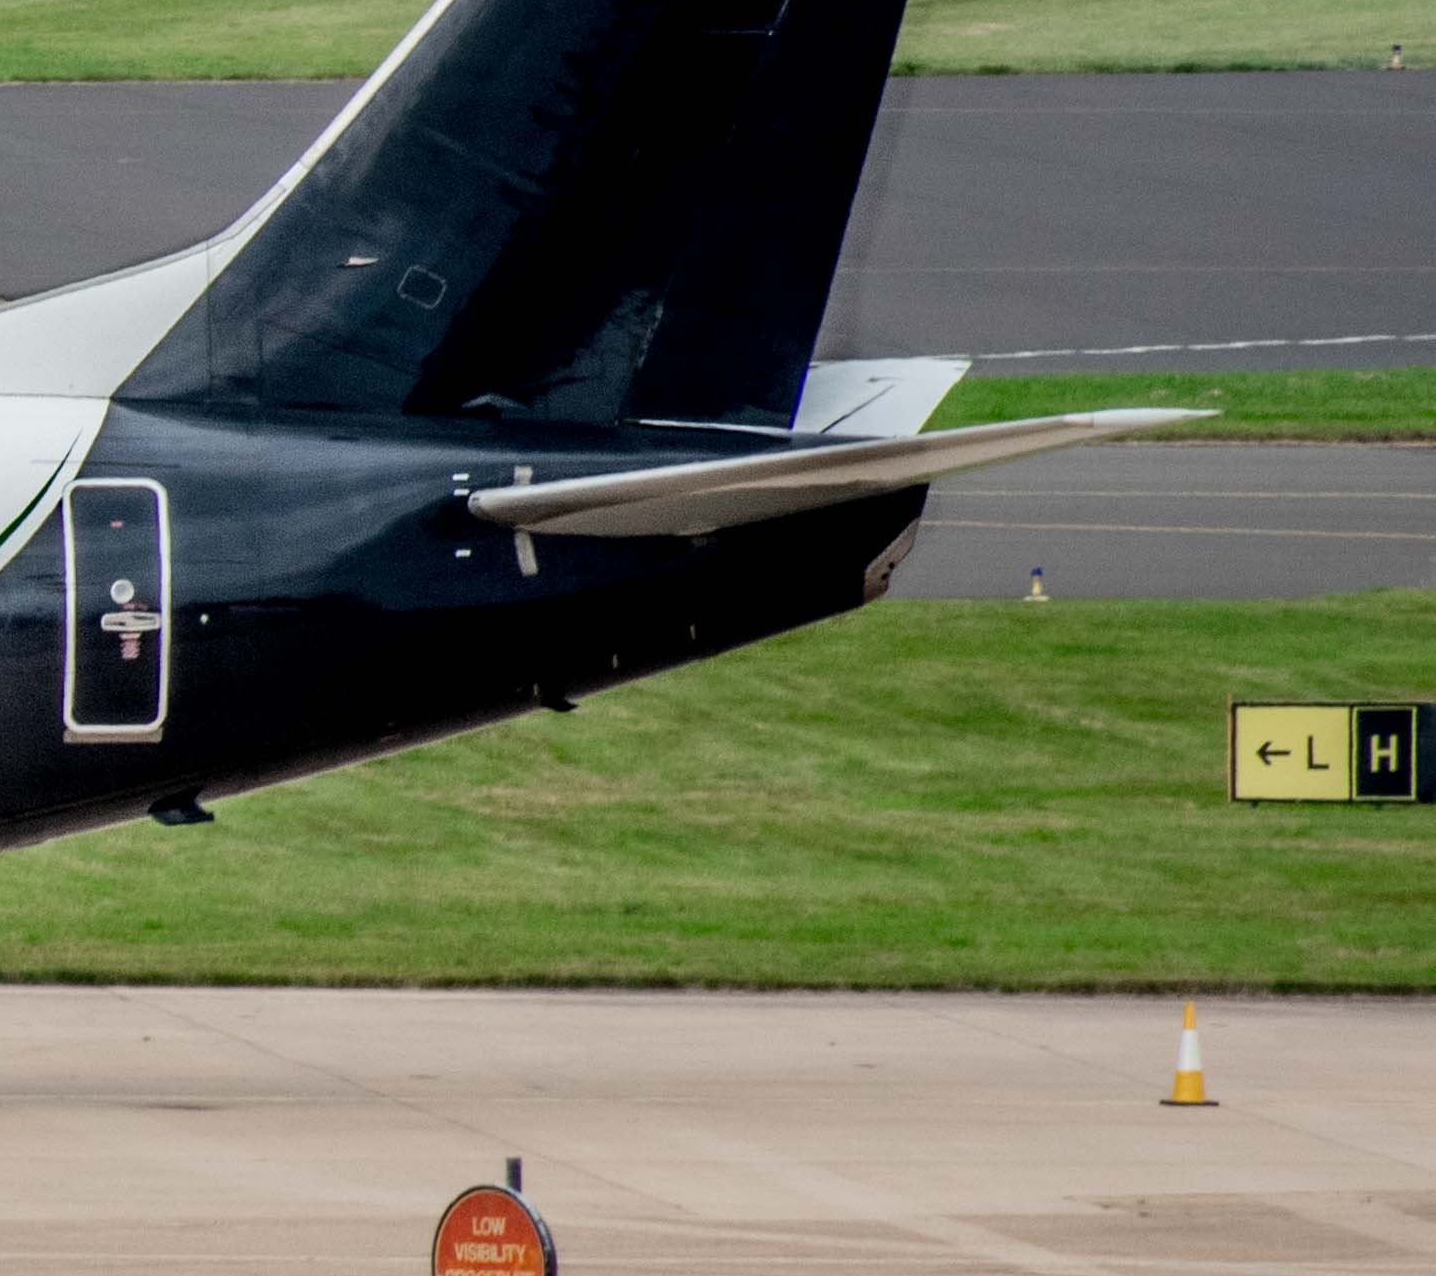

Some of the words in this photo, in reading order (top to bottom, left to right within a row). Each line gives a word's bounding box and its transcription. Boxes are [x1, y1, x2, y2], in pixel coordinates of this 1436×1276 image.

[1307, 735, 1329, 769] L
[1371, 734, 1398, 773] H
[472, 1217, 506, 1236] LOW
[454, 1243, 526, 1264] VISIBILITY
